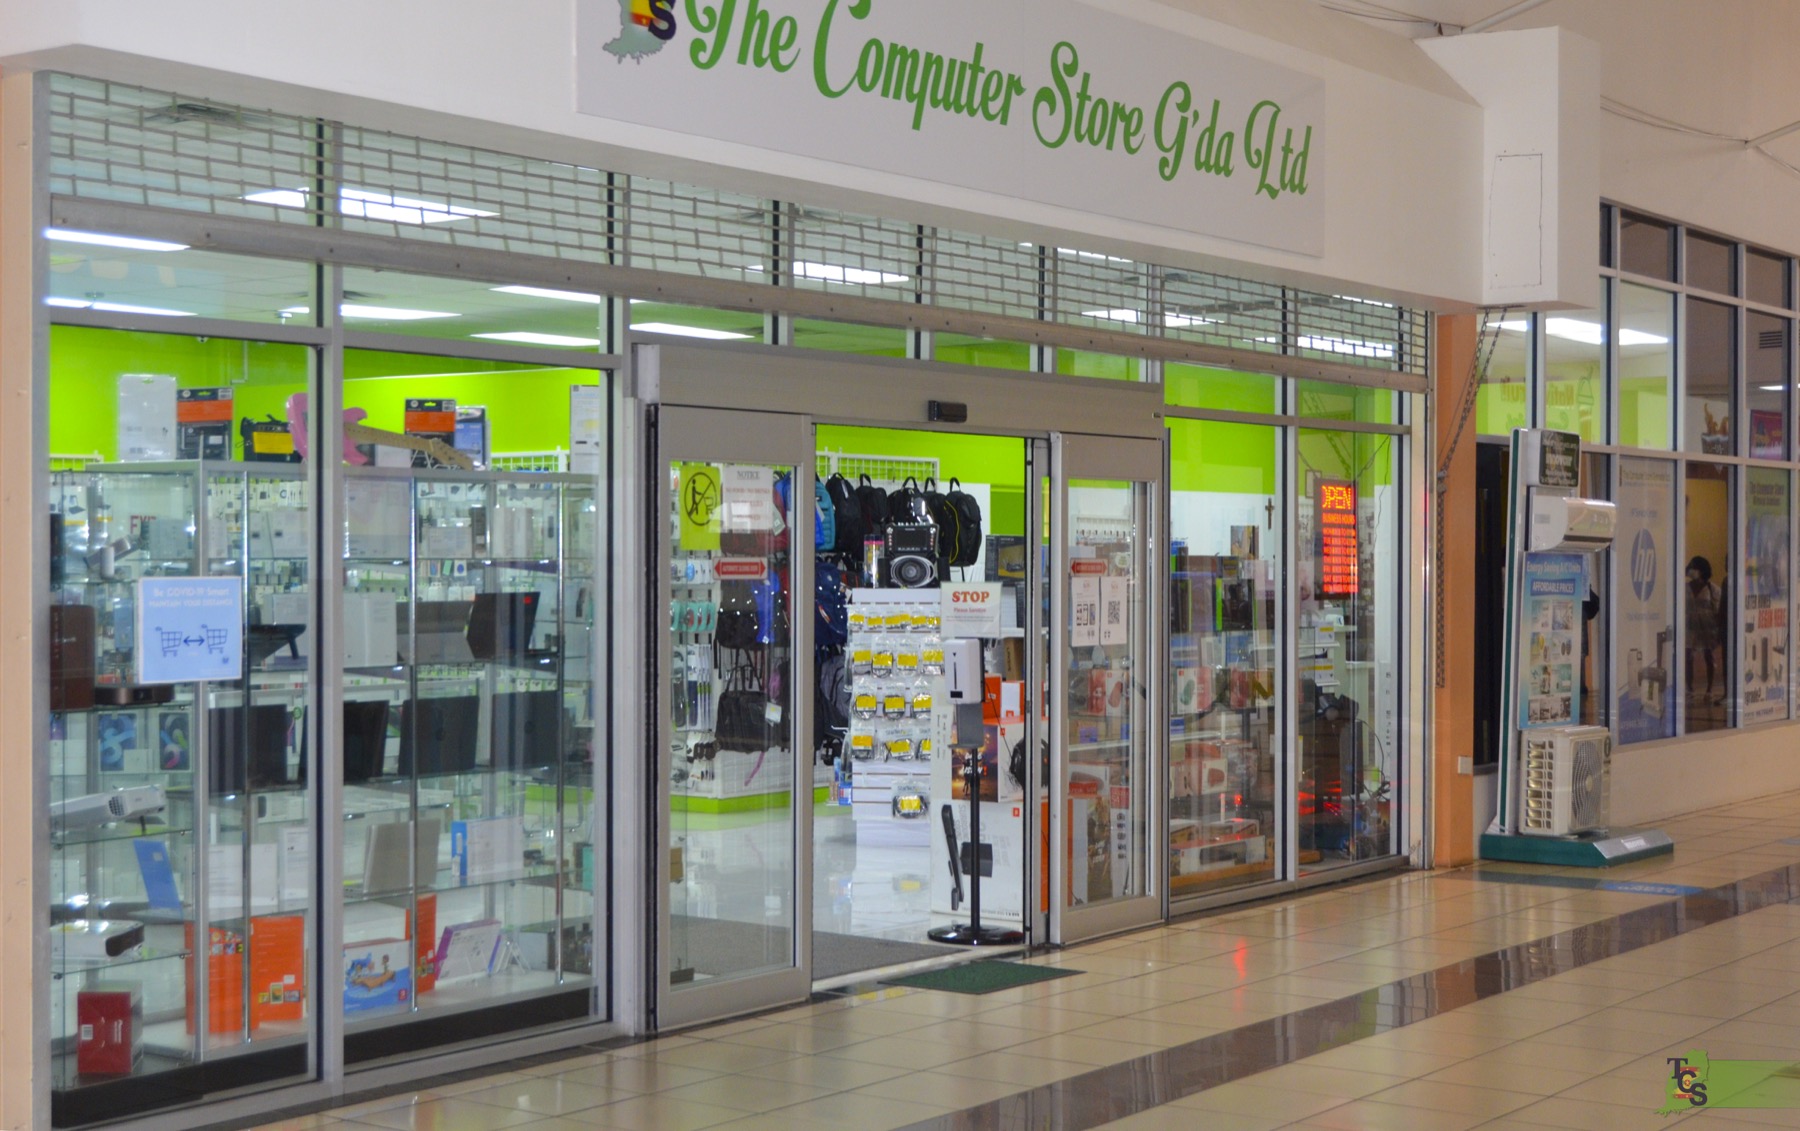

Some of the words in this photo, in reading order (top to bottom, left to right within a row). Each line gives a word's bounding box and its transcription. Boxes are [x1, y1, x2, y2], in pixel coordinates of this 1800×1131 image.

[685, 0, 801, 73] The
[813, 0, 1027, 131] Computer
[1032, 41, 1146, 155] Store
[1153, 81, 1235, 182] G'da
[1243, 99, 1313, 200] Ltd
[1527, 561, 1543, 575] Energy
[1532, 581, 1559, 592] AFFORDABLE
[1559, 583, 1574, 593] PRICES
[952, 591, 990, 603] STOP
